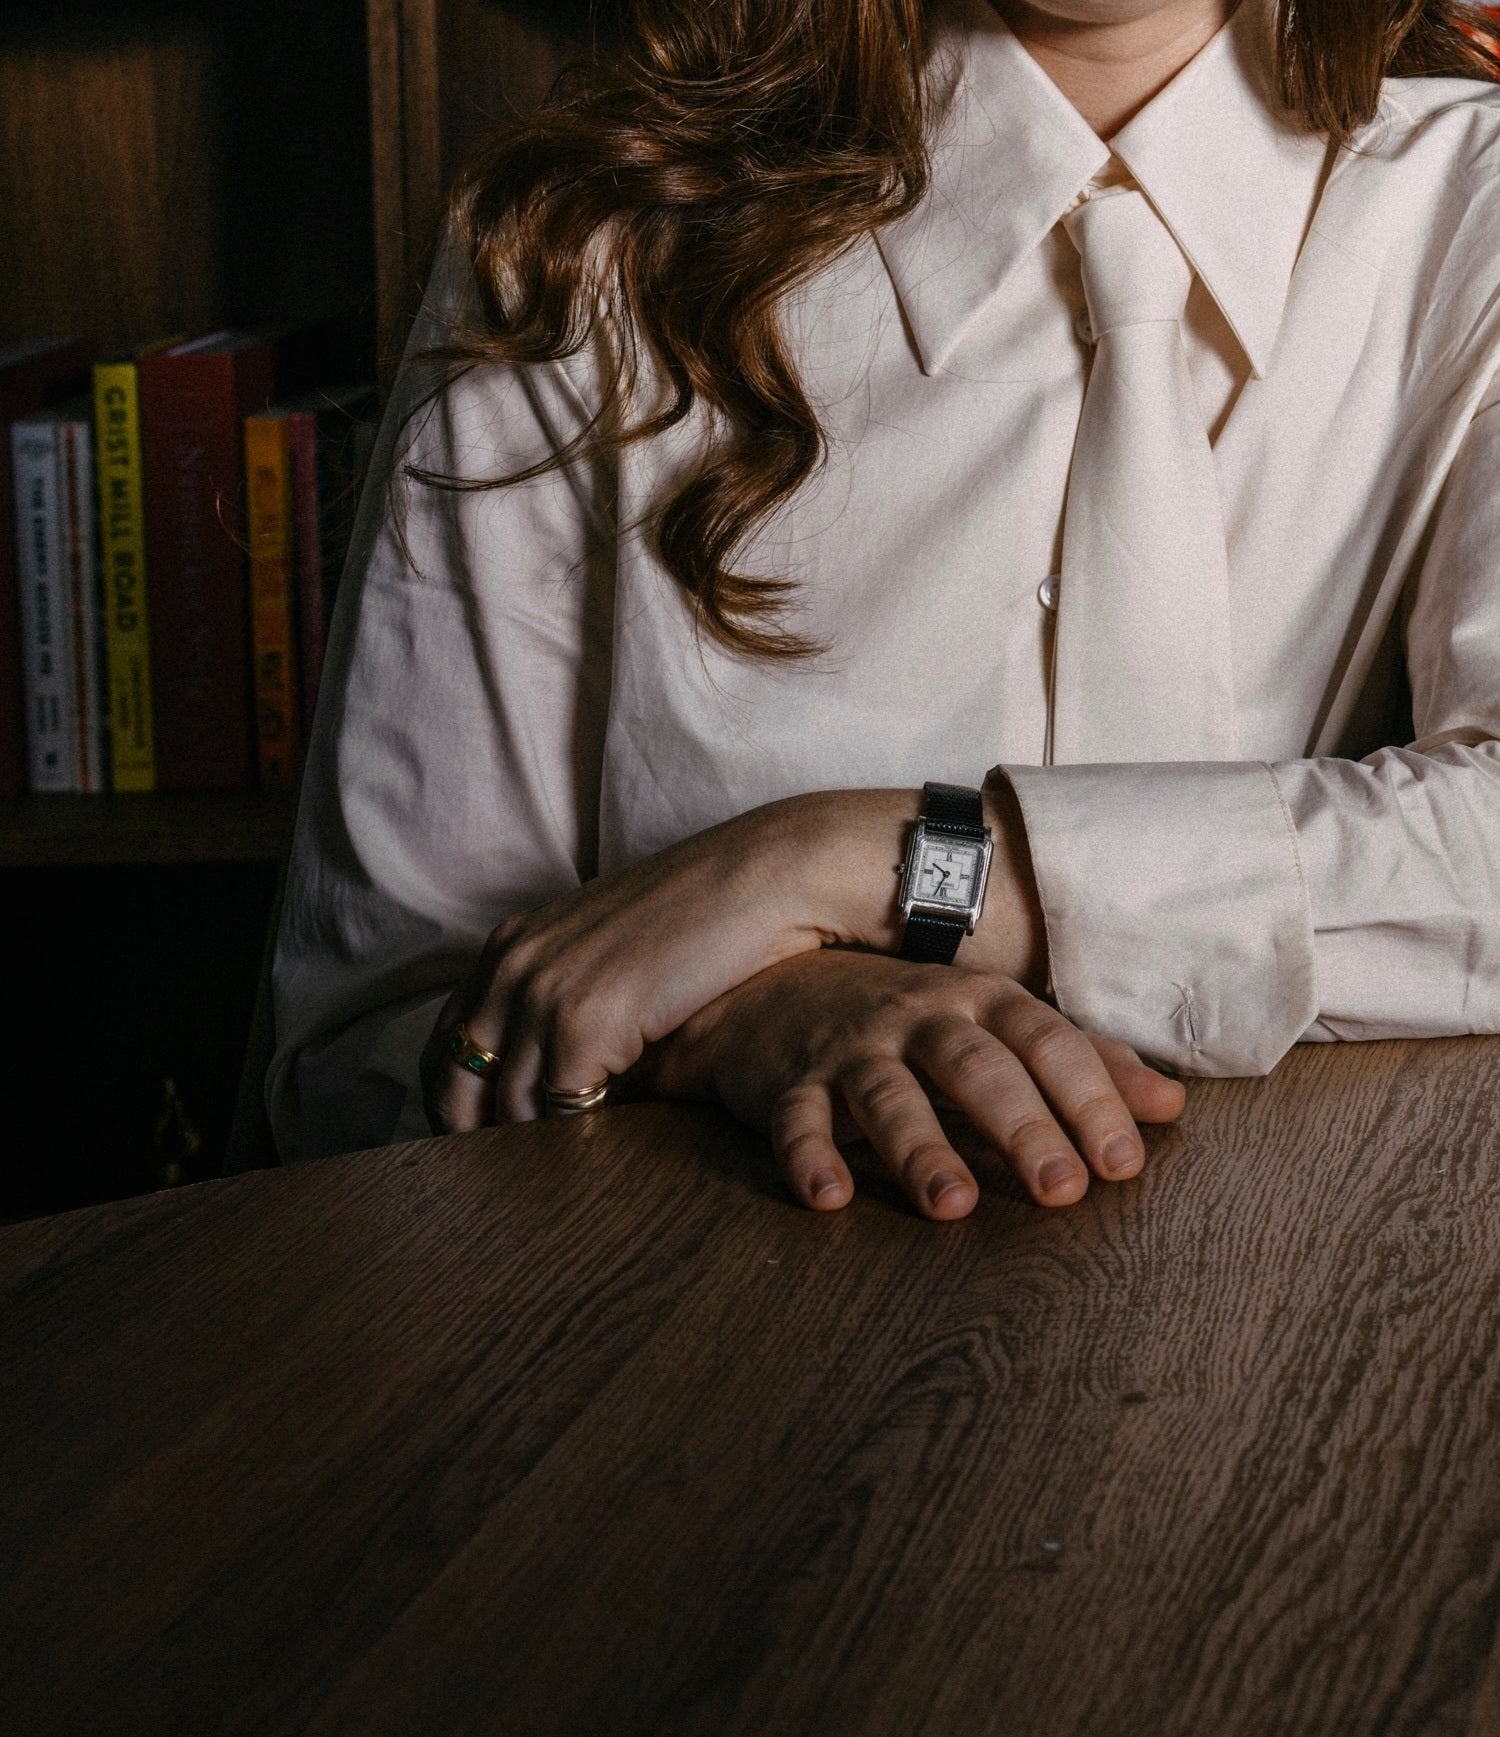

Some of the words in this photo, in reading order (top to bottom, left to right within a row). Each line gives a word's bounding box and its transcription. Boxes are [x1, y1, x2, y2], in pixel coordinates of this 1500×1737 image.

[104, 385, 131, 468] GRIST
[108, 479, 132, 540] MILL
[113, 548, 138, 633] ROAD
